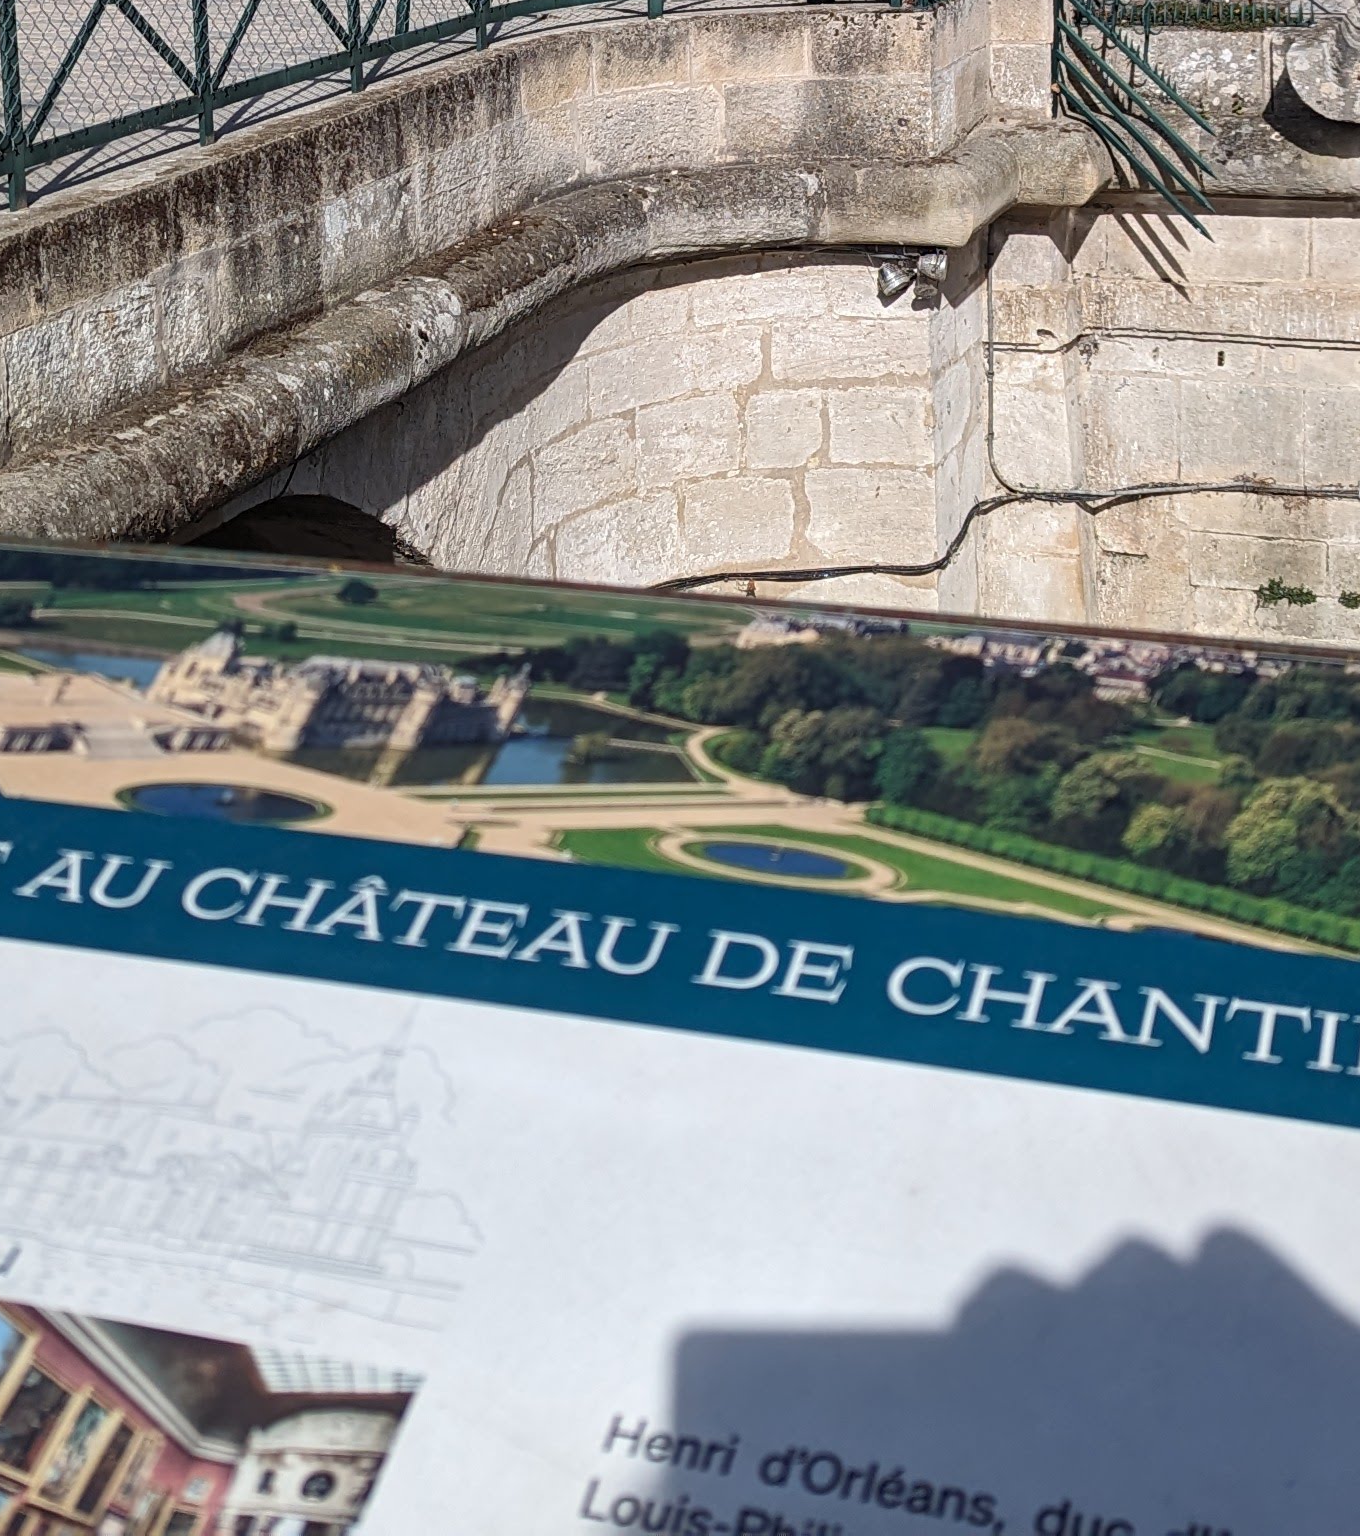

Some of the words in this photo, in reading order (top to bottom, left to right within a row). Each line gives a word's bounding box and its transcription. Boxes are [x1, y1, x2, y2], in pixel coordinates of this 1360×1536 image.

[14, 848, 173, 910] AU
[180, 867, 680, 975] CHÂTEAU
[691, 928, 855, 1004] DE
[601, 1411, 740, 1477] Henri
[579, 1477, 844, 1536] Louis-Ph
